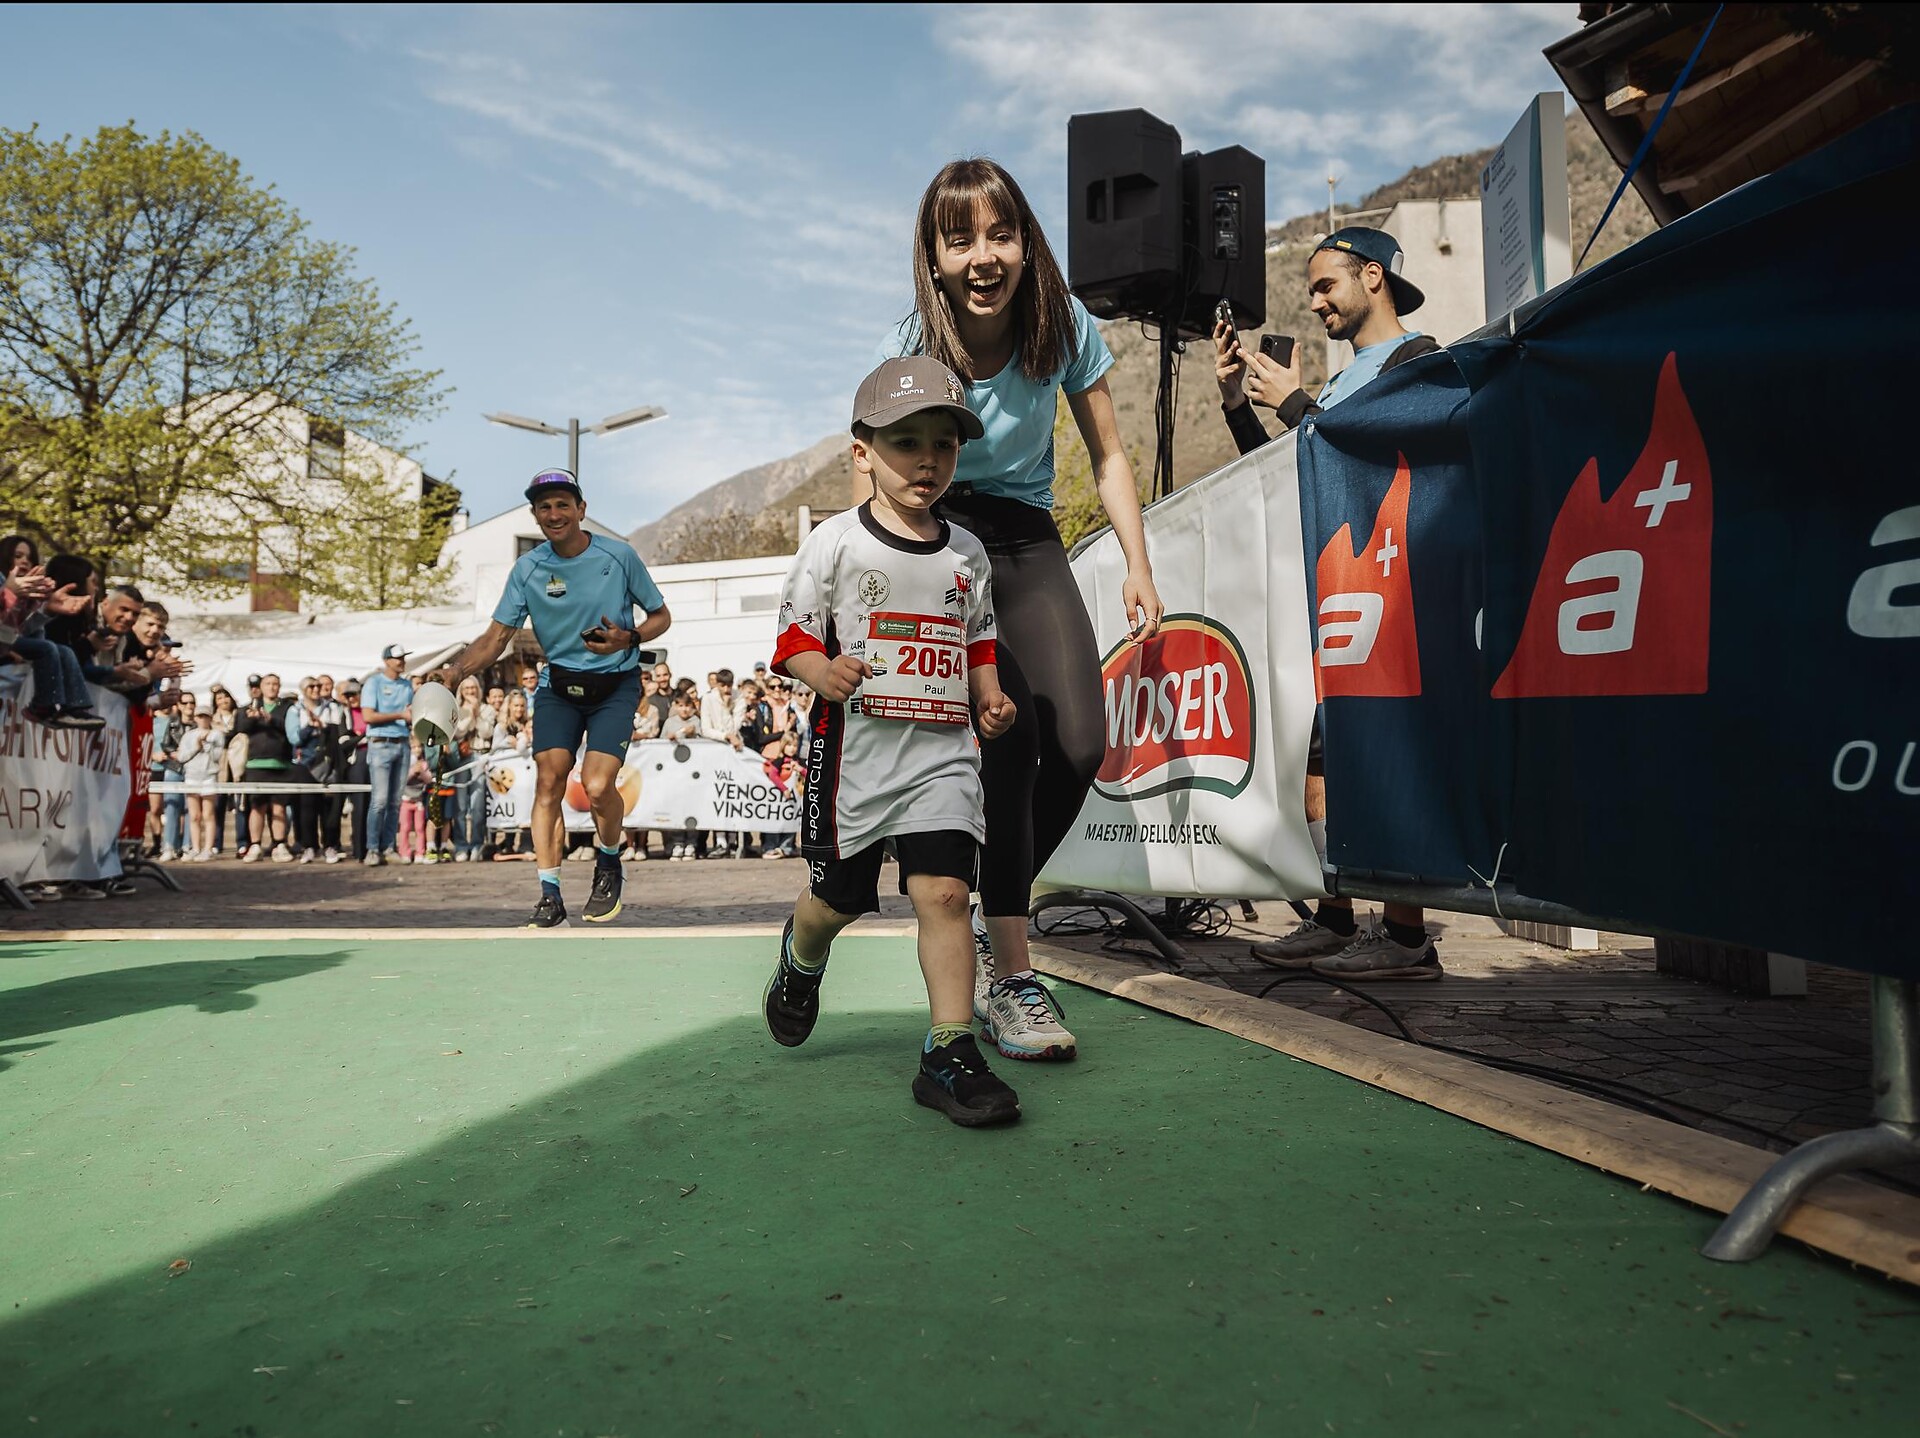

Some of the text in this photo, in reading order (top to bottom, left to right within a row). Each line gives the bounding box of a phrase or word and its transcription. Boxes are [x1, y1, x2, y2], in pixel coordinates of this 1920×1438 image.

[897, 645, 964, 681] 2054
[924, 683, 946, 696] Paul
[1105, 662, 1233, 749] MOSER
[715, 770, 734, 781] VAL
[809, 738, 825, 841] SPORTCLUB
[1084, 823, 1222, 845] MAESTRI DELLO SPECK
